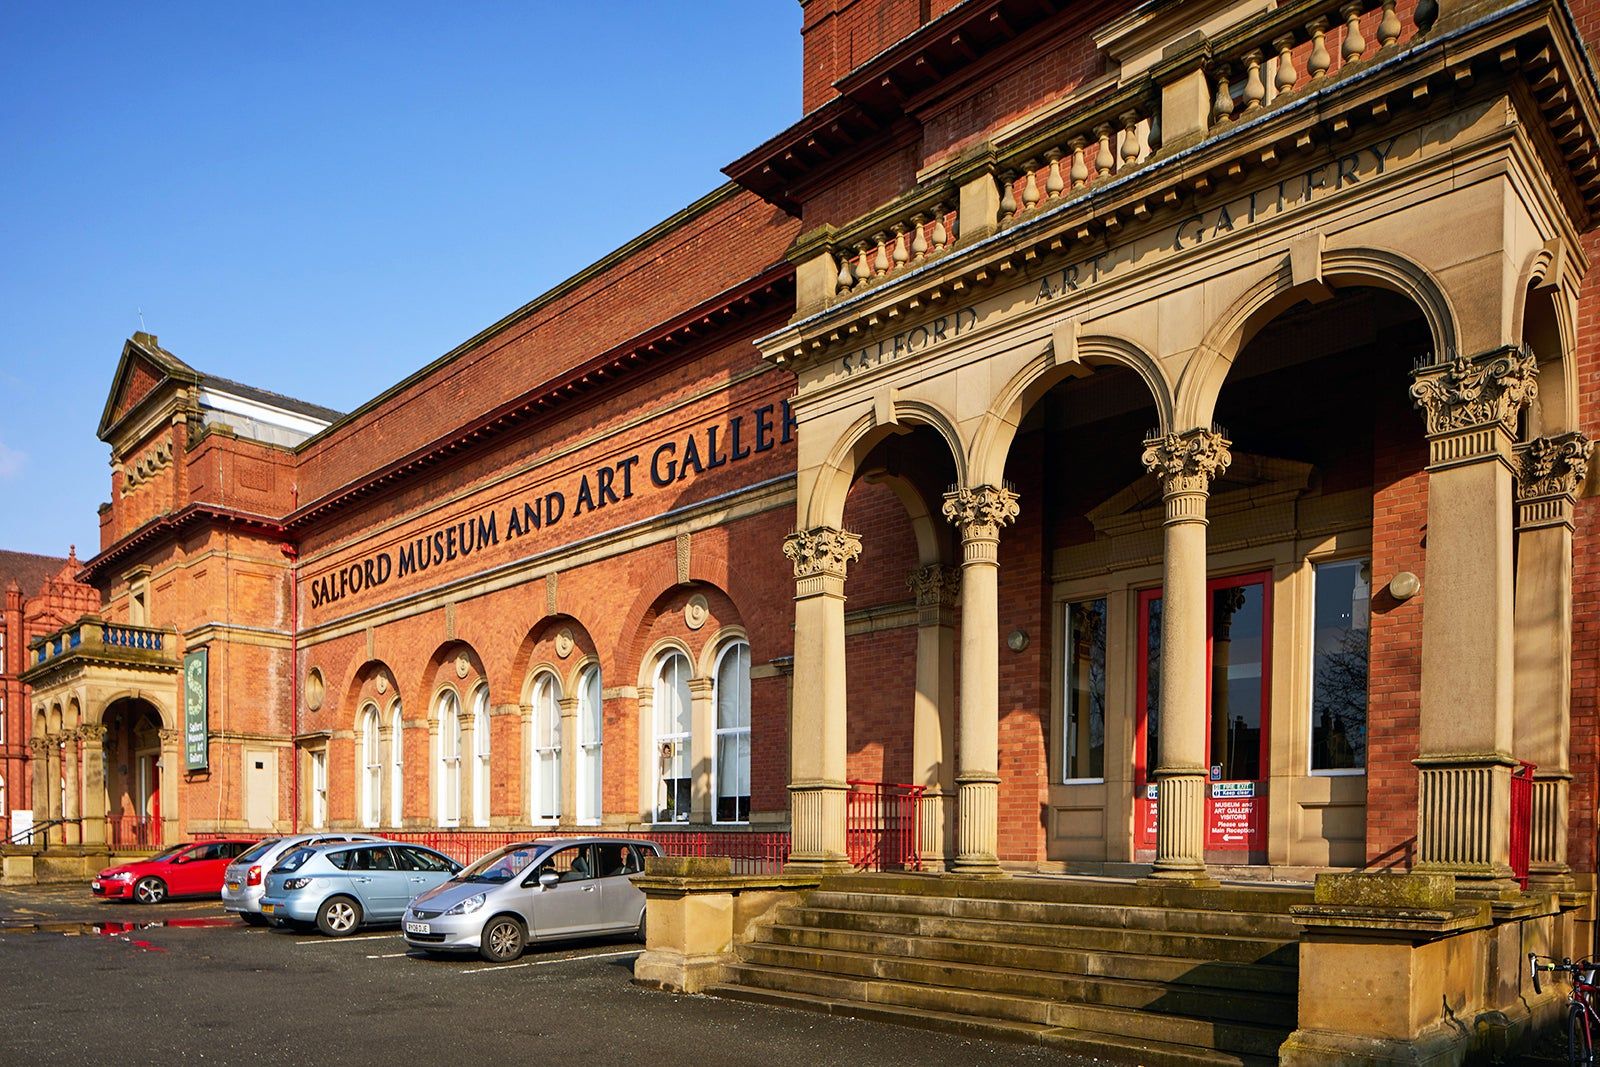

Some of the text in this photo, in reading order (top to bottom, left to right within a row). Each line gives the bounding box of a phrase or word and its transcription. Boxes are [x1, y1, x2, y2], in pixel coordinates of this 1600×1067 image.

[842, 137, 1401, 378] SALFORD ART GALLERY
[310, 399, 797, 609] SALFORD MUSEUM AND ART GALLER
